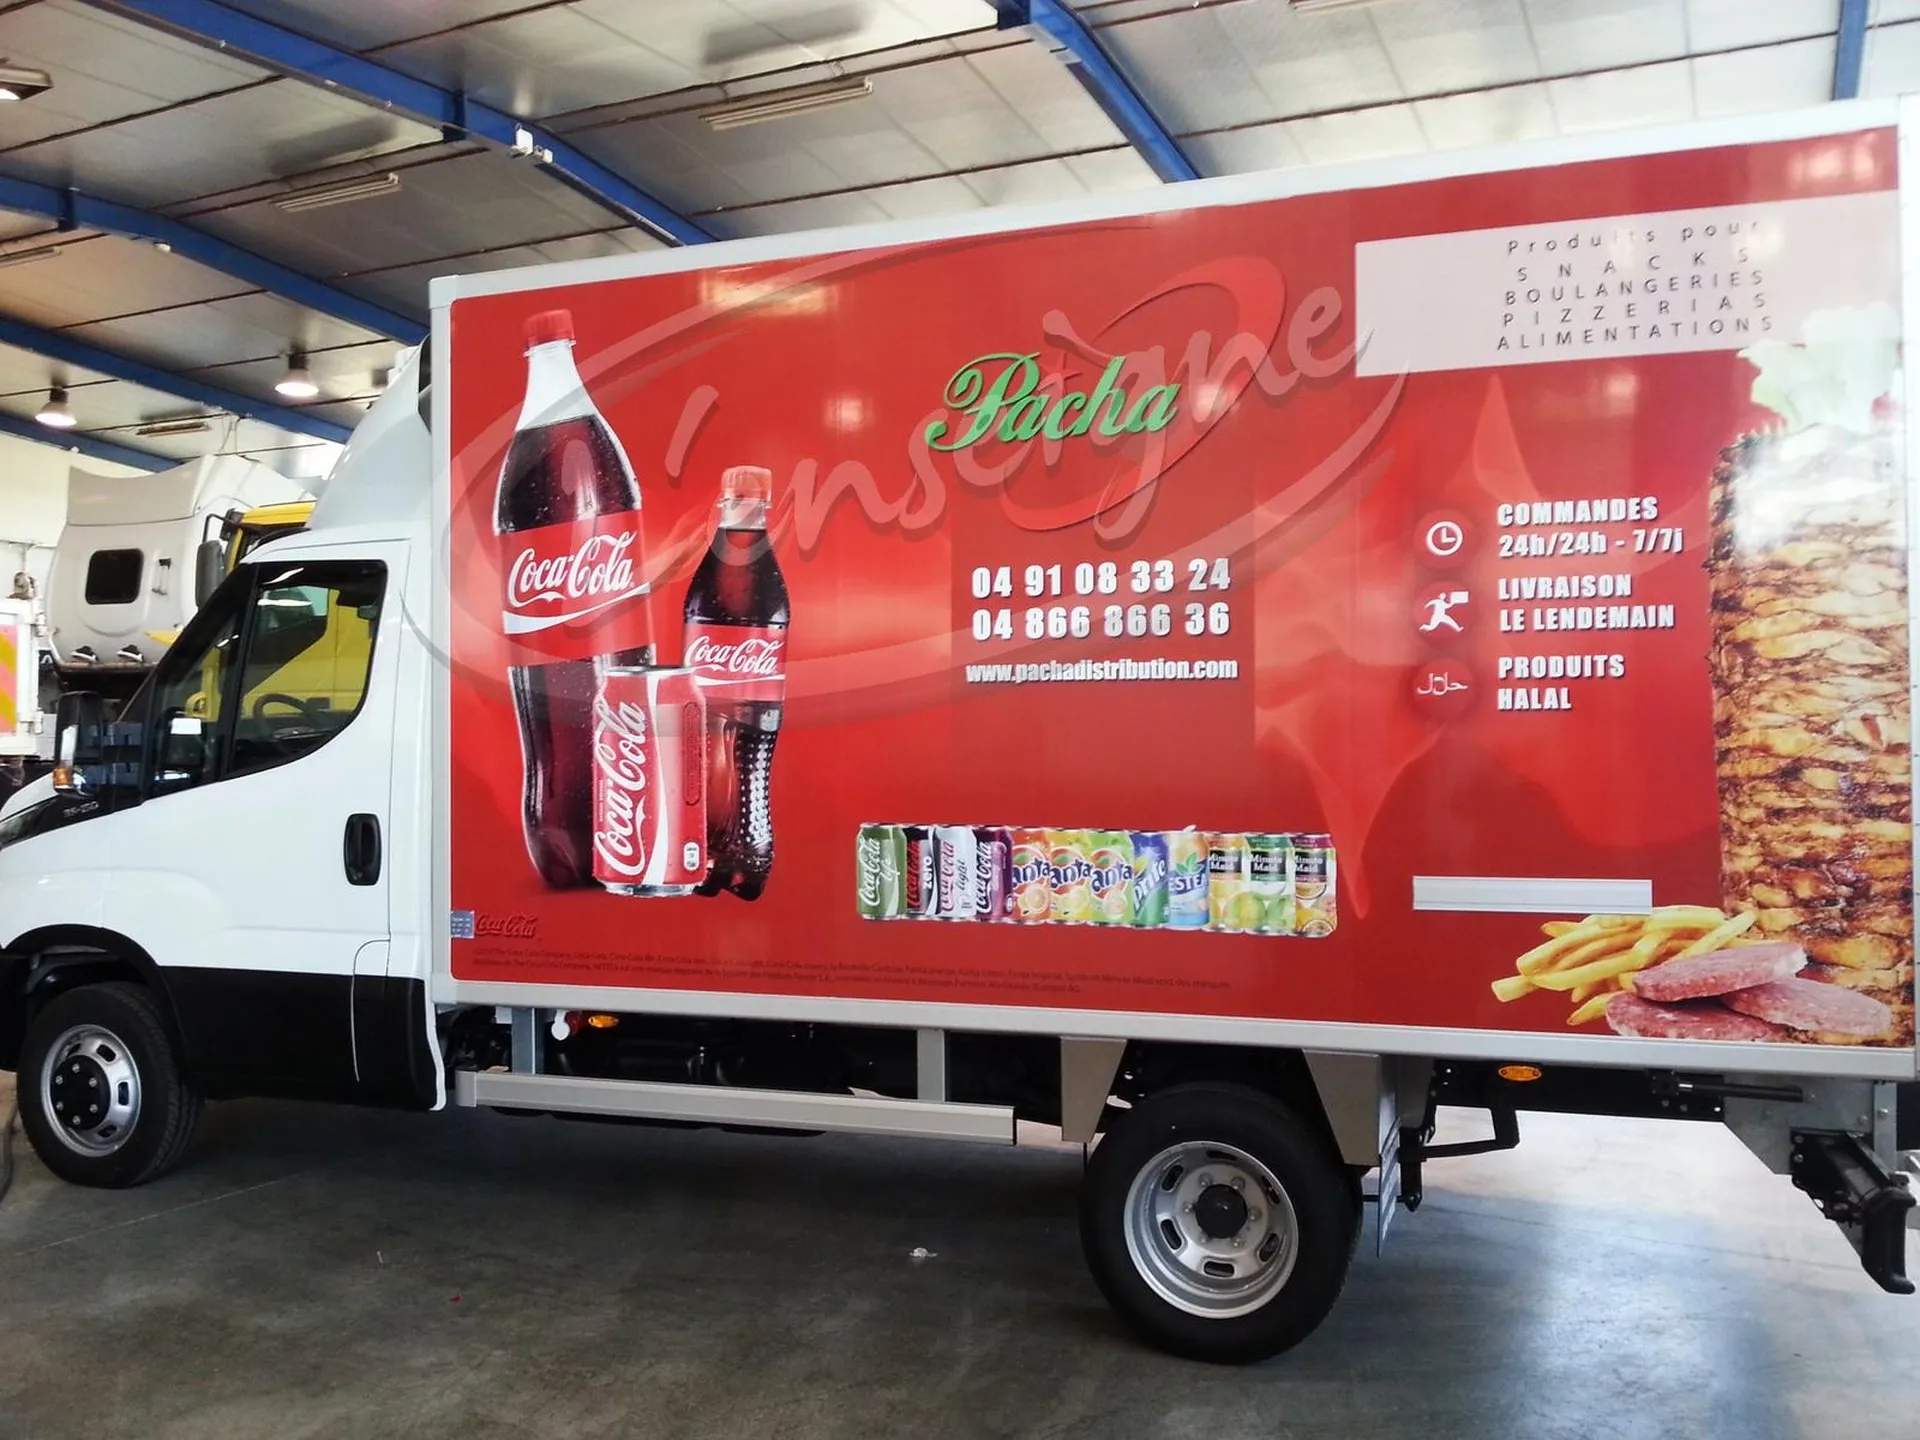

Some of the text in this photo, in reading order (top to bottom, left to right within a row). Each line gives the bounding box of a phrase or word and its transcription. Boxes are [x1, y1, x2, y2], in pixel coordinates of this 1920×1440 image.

[1507, 220, 1759, 254] Produits pour
[1516, 248, 1749, 282] SNACKS
[1506, 269, 1763, 305] BOULANGERIES
[1503, 293, 1766, 328] PIZZERIAS
[1498, 316, 1773, 351] ALIMENTATIONS
[924, 352, 1182, 452] Pacha
[1497, 497, 1659, 526] COMMANDES
[1498, 530, 1608, 558] 24h/24h
[1632, 528, 1684, 554] 7/7j
[508, 531, 637, 609] Coca-Cola
[971, 557, 1232, 599] 04 91 08 33 24
[1498, 574, 1632, 600] LIVRAISON
[972, 601, 1231, 641] 04 866 866 36
[1500, 604, 1675, 632] LE LENDEMAIN
[687, 635, 785, 675] Coca-Cola
[965, 658, 1239, 684] www.pachadistribution.com
[1497, 654, 1626, 679] PRODUITS
[1497, 686, 1573, 711] HALAL
[594, 694, 646, 876] Coca-Cola
[923, 856, 933, 890] zero
[1012, 858, 1051, 888] anta
[1050, 859, 1093, 889] anta
[1091, 861, 1133, 892] anta
[1134, 859, 1166, 912] prite
